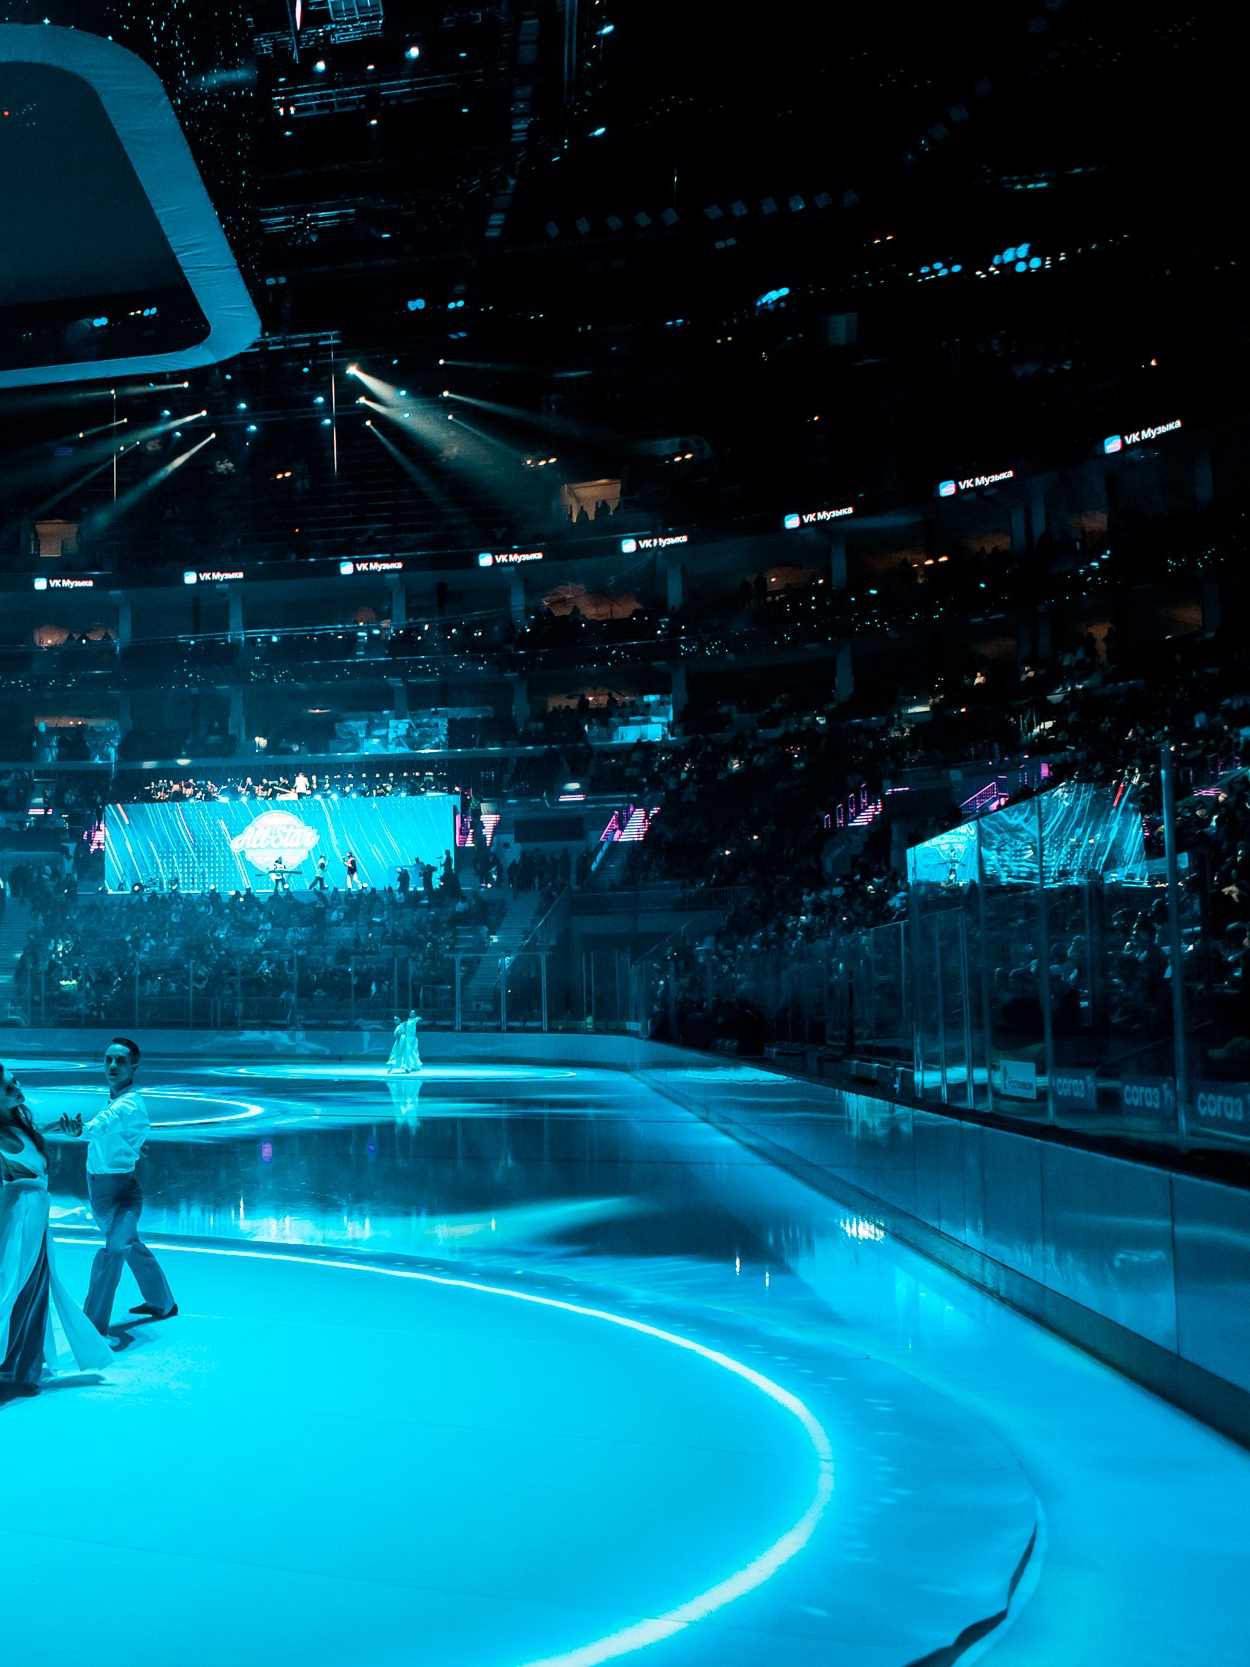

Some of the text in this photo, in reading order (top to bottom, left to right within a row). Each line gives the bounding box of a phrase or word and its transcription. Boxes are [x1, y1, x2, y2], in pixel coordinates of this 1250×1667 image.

[1123, 419, 1182, 445] VK Музыка
[957, 470, 1014, 490] VK Музыка
[802, 506, 854, 524] VK Музыка
[638, 539, 652, 549] VK
[494, 551, 543, 564] VK Музыка
[355, 563, 368, 572] VK
[48, 579, 61, 588] VK
[198, 572, 211, 582] VK
[232, 825, 319, 850] All-Star
